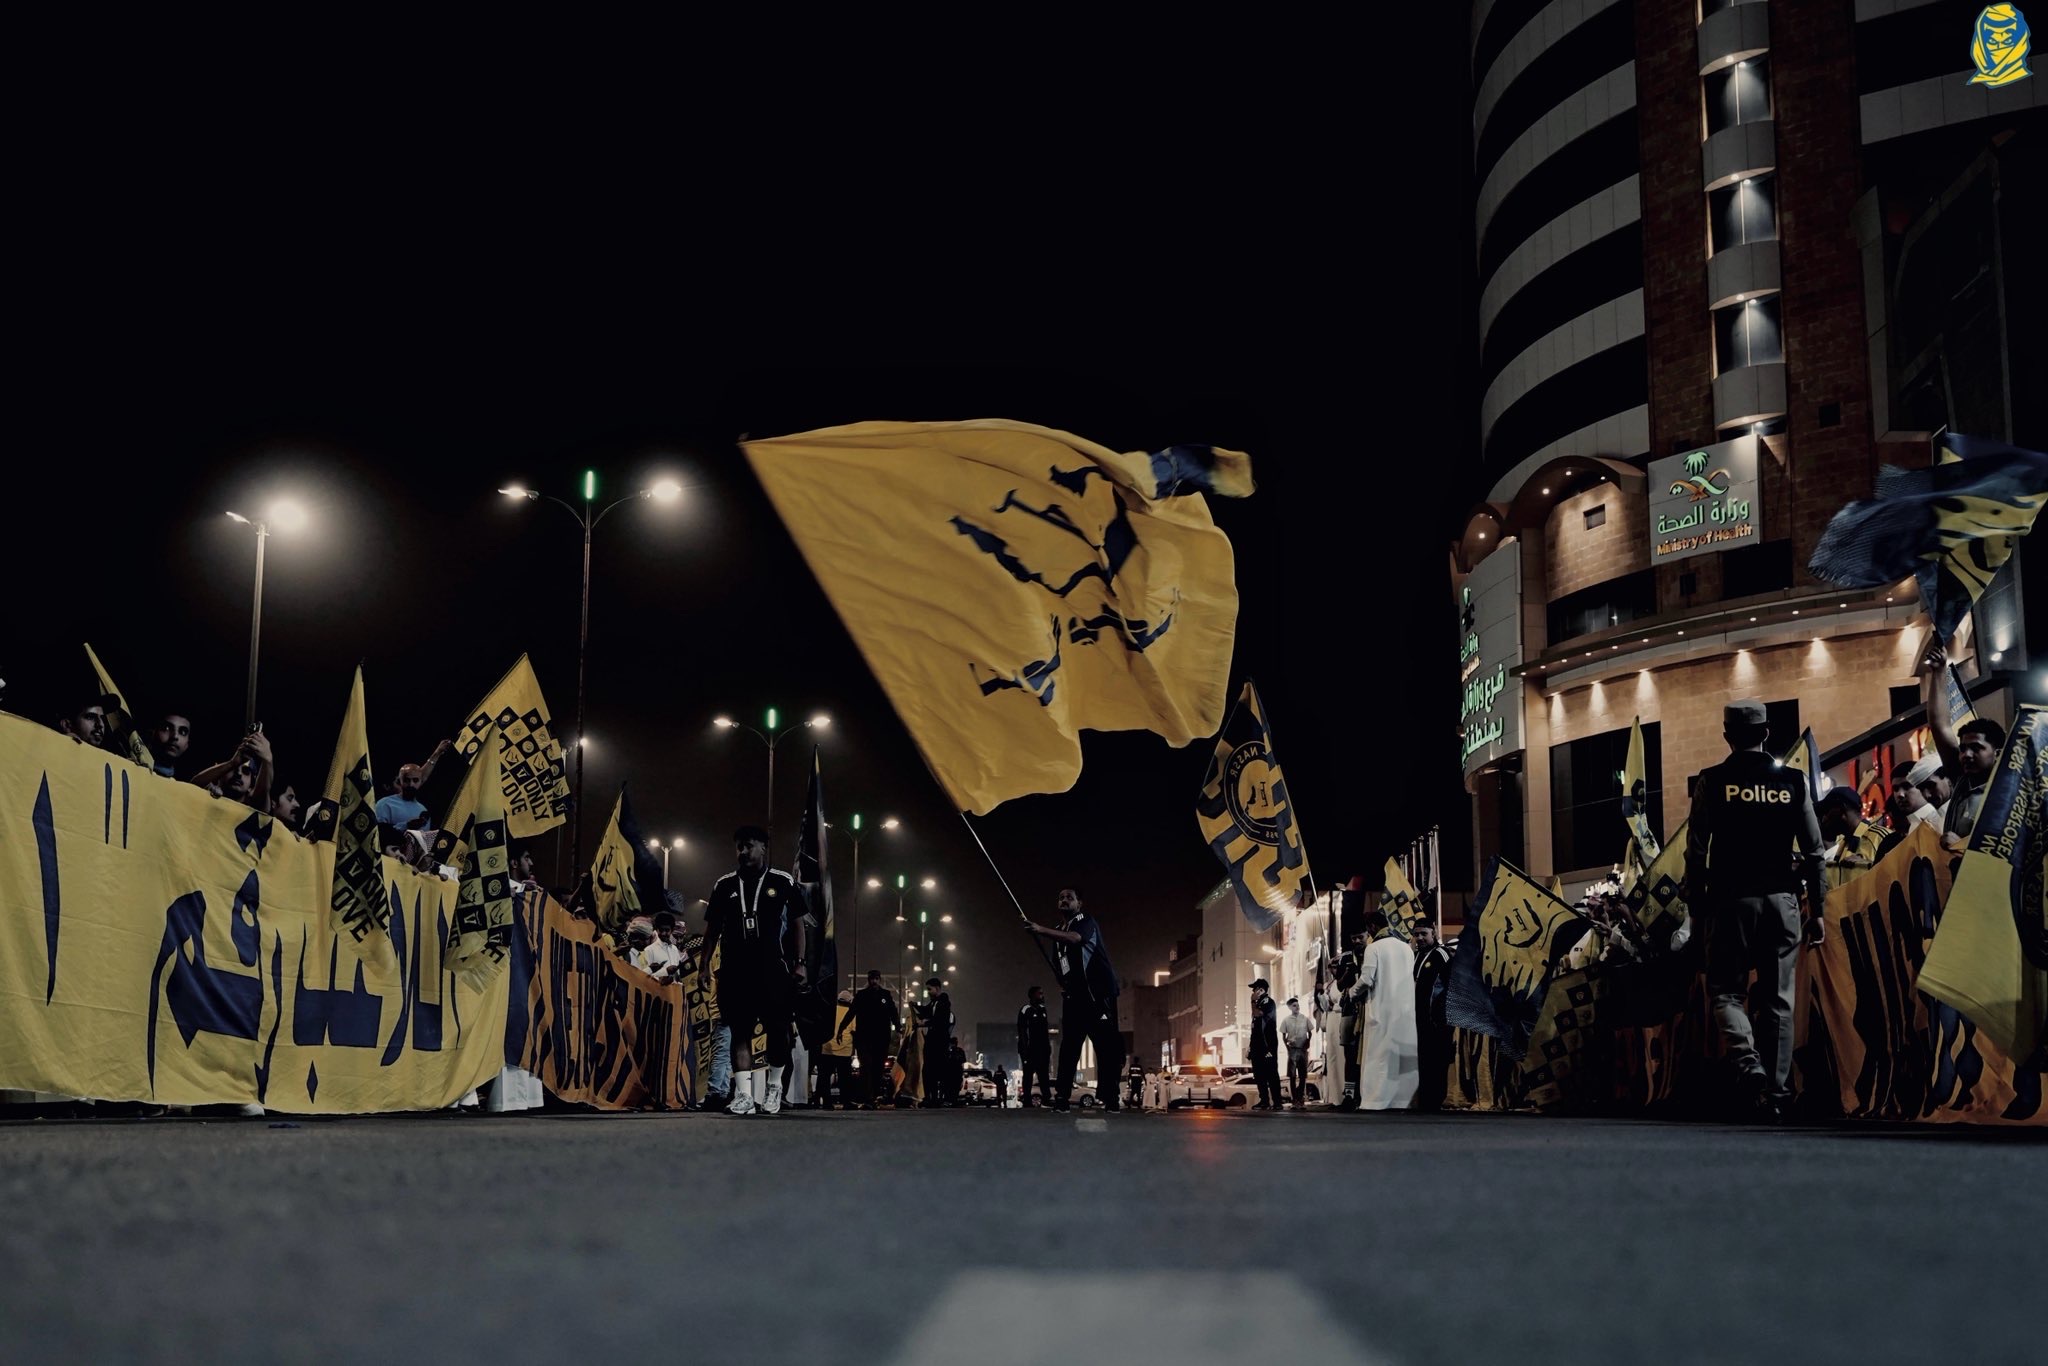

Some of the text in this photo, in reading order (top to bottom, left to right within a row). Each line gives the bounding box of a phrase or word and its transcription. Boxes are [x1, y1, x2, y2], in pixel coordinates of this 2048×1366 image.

[1657, 497, 1750, 535] وزارة الصحة
[1656, 522, 1753, 556] Ministry of Health
[1485, 663, 1505, 713] فرع
[523, 779, 551, 821] ONLY
[1725, 784, 1791, 804] Police
